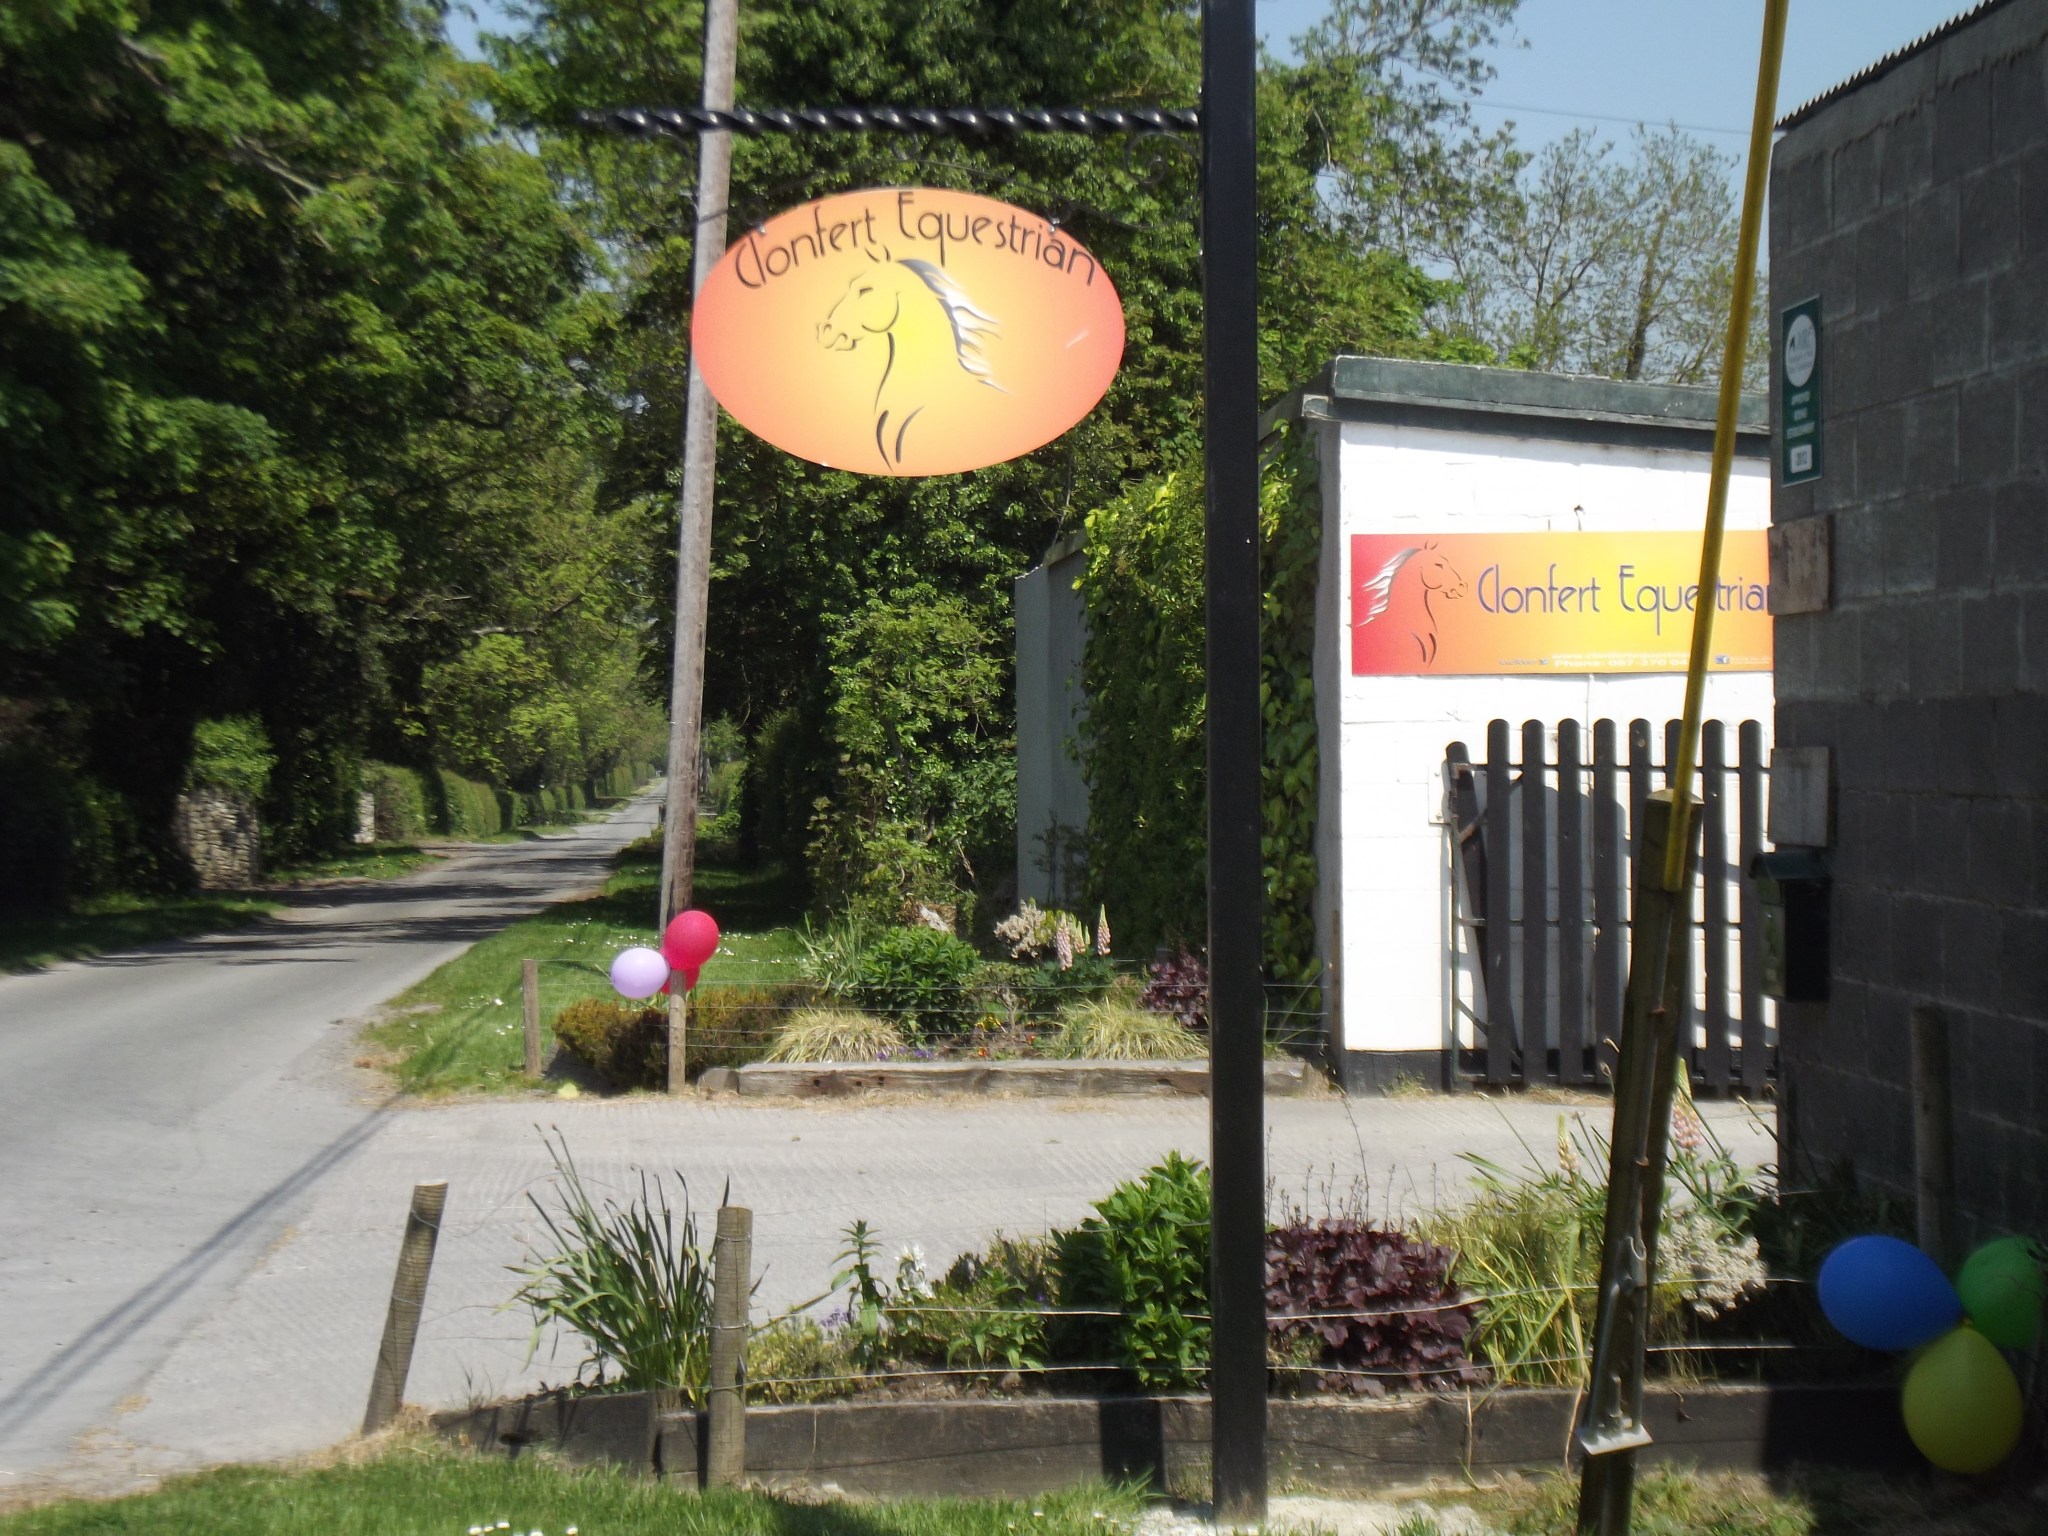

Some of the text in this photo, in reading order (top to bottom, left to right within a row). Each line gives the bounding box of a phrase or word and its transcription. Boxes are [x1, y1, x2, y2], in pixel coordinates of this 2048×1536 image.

[734, 191, 1097, 289] Clonfert Equestrian
[1477, 563, 1770, 636] Clonfert Equetria
